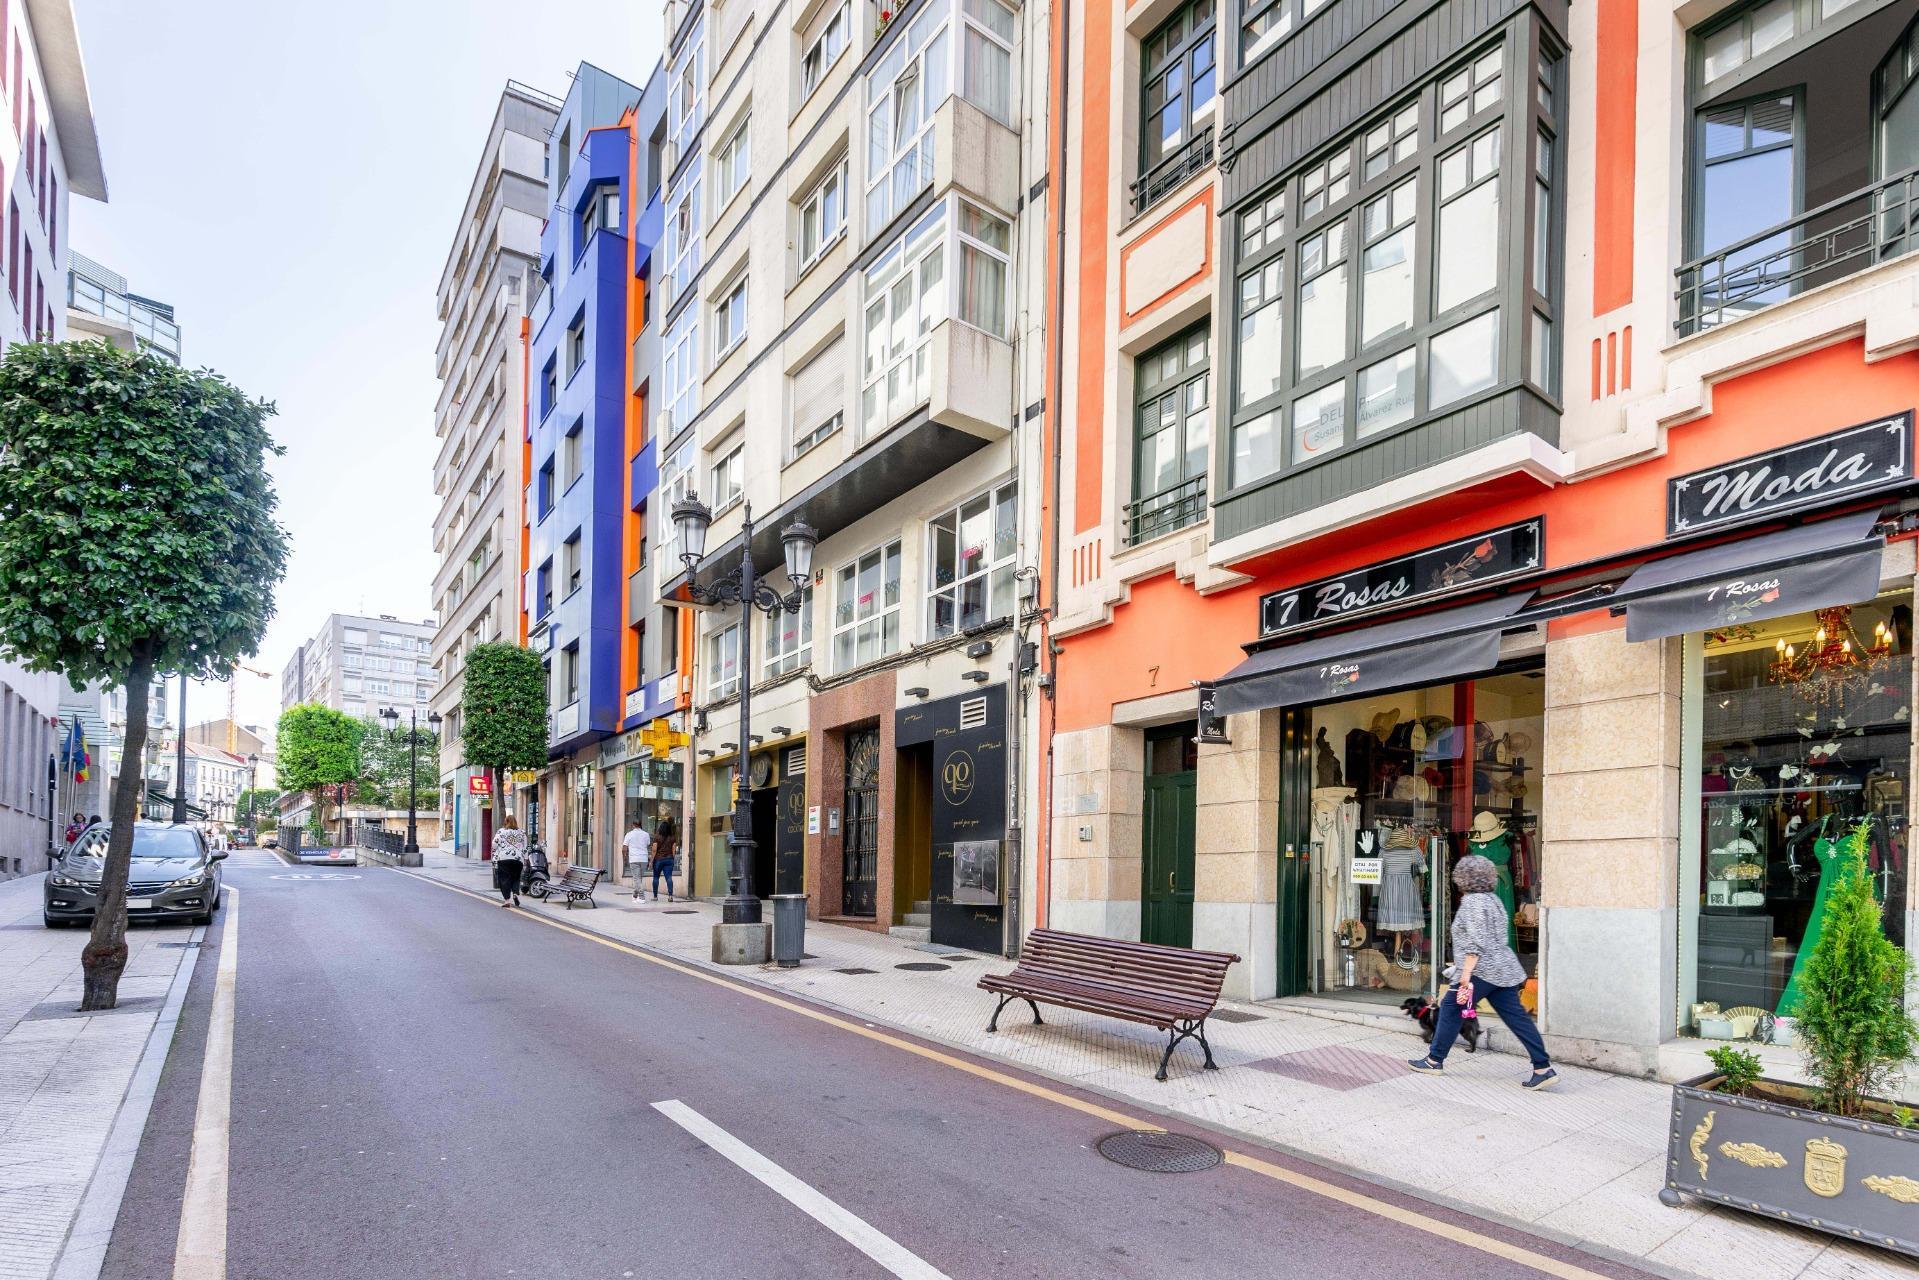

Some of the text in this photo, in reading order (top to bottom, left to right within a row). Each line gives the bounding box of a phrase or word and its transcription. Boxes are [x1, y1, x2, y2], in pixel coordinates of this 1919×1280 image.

[1702, 449, 1873, 516] Moda
[1279, 576, 1411, 625] 7 Rosas
[1707, 579, 1781, 601] 7 Rosas
[1148, 665, 1160, 687] 7
[1320, 664, 1360, 679] 7 Rosas
[1201, 700, 1216, 711] Ro
